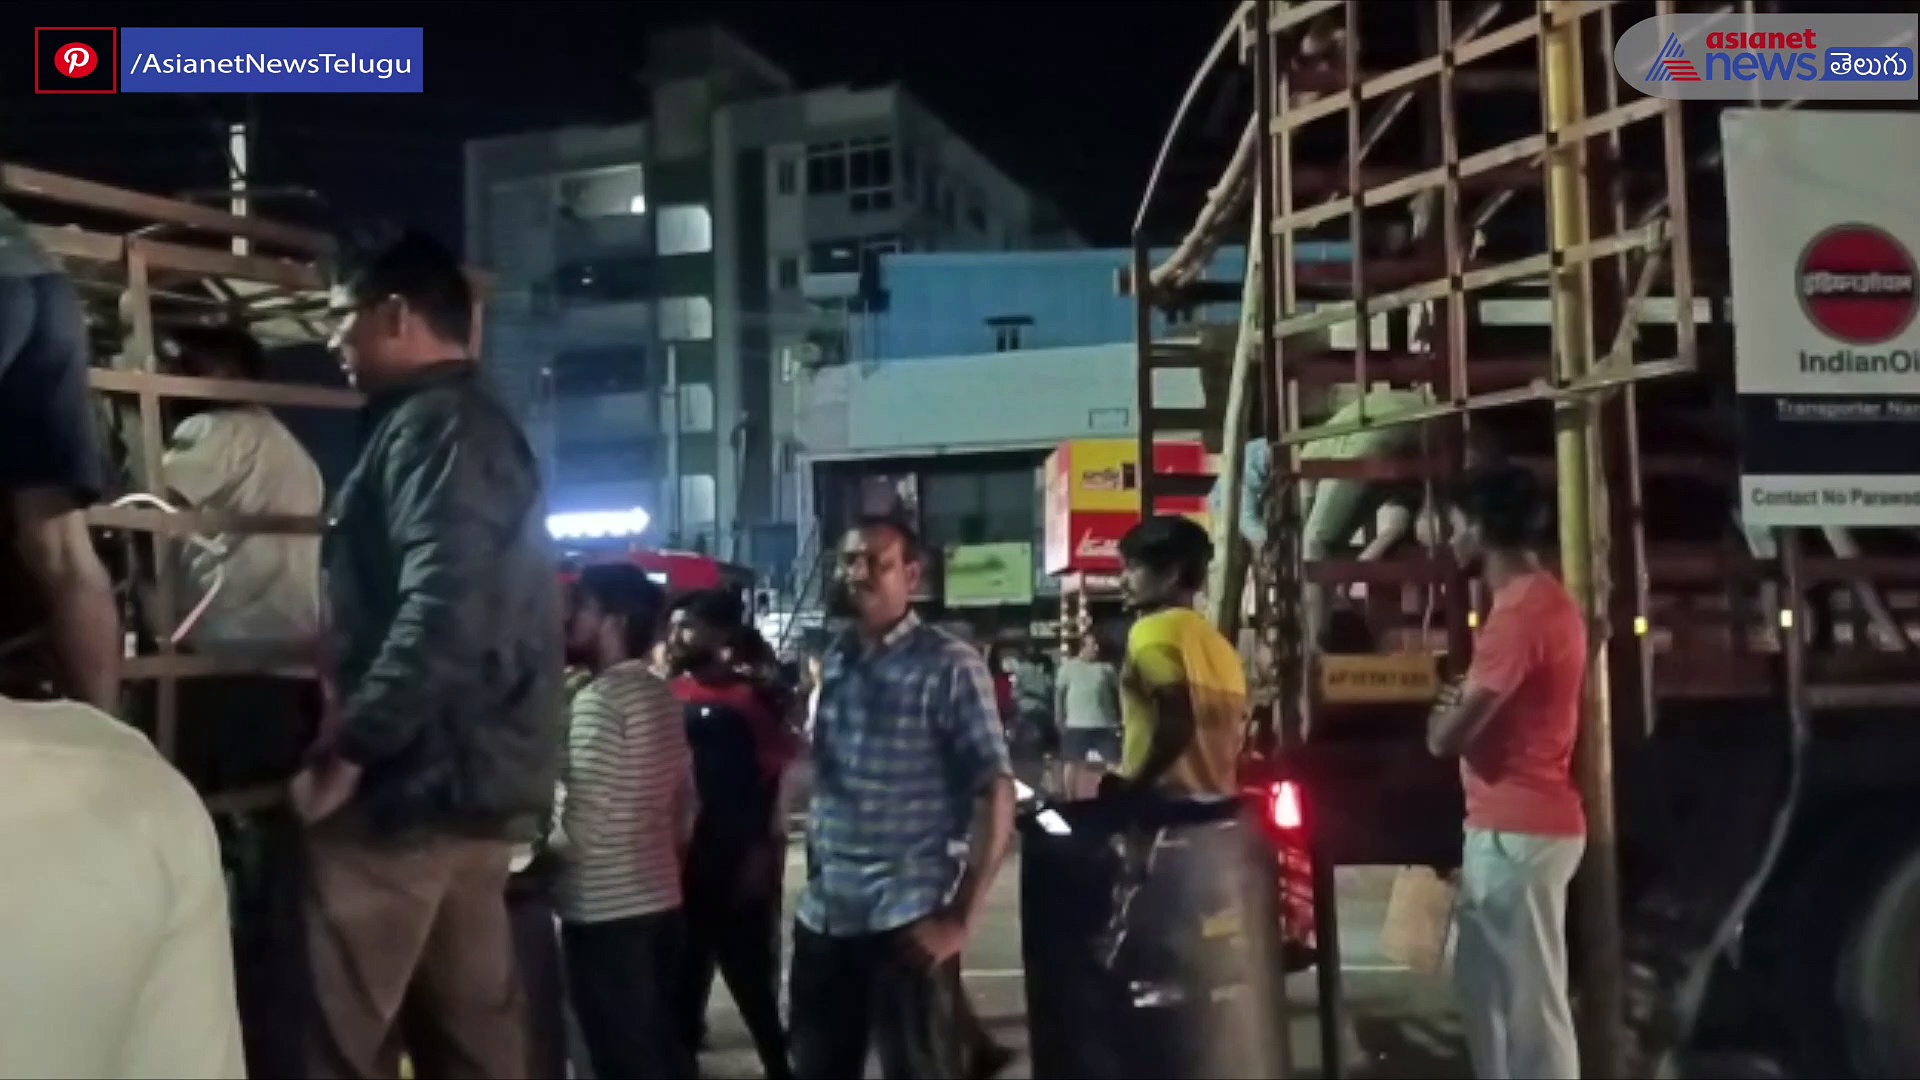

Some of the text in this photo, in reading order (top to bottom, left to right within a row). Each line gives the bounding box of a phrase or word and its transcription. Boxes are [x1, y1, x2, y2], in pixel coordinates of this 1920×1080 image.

[1776, 398, 1880, 420] Transporter
[1751, 486, 1816, 507] Contact
[1822, 487, 1847, 505] No
